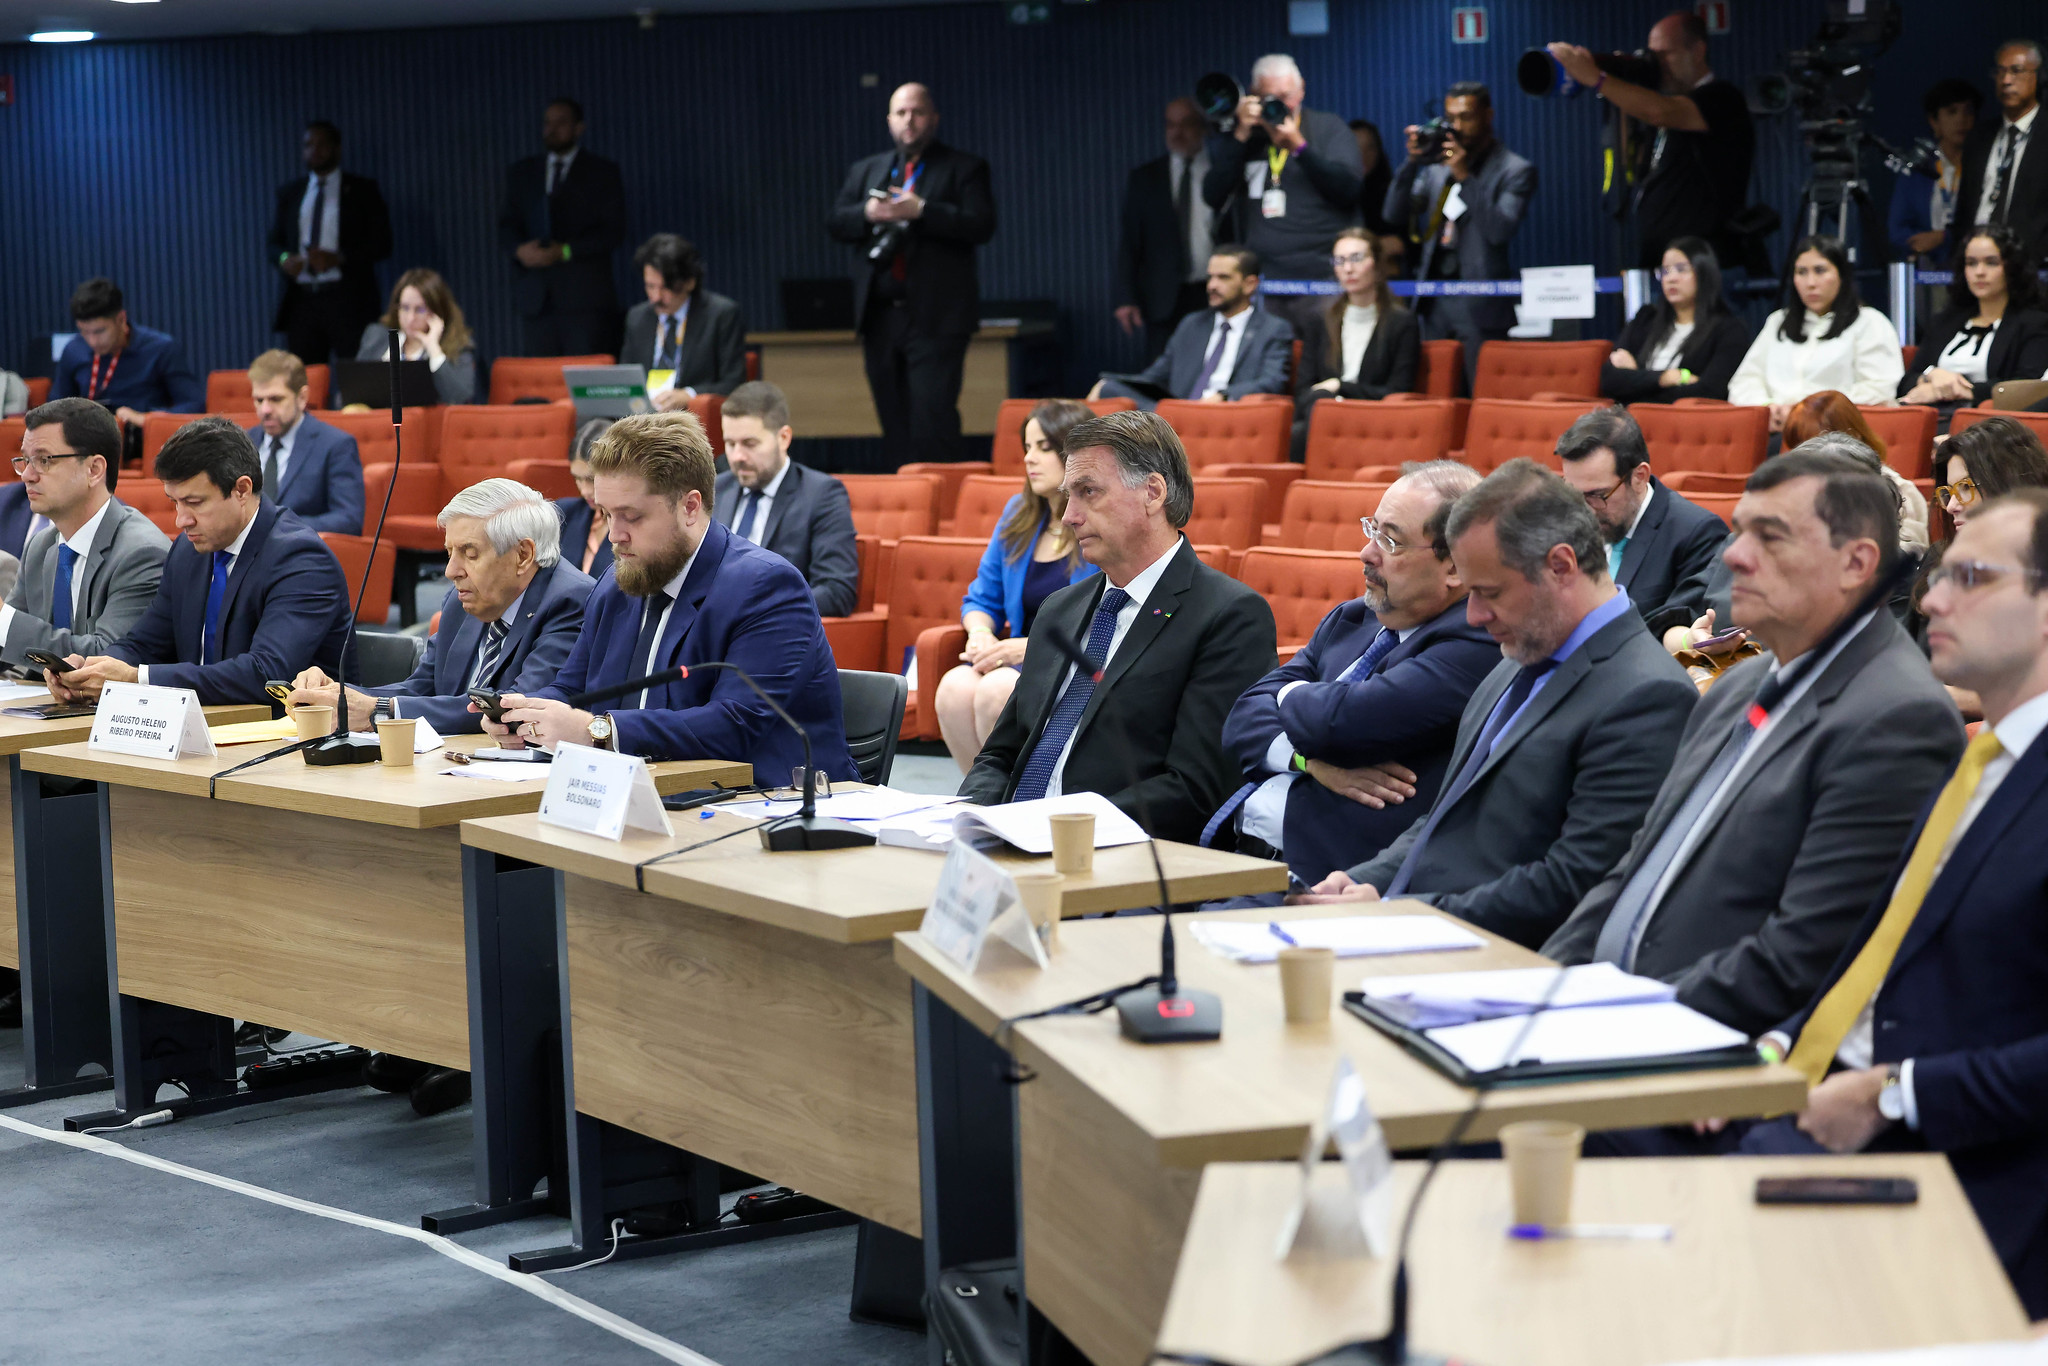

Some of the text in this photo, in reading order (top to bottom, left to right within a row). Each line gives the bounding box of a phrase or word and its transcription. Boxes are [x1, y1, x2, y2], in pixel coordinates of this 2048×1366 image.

[110, 714, 167, 729] AUGUSTO HELENO
[109, 726, 162, 741] RIBEIRO PEREIRA
[567, 777, 607, 795] JAIR MESSIAS
[565, 792, 602, 809] BOLSONARO
